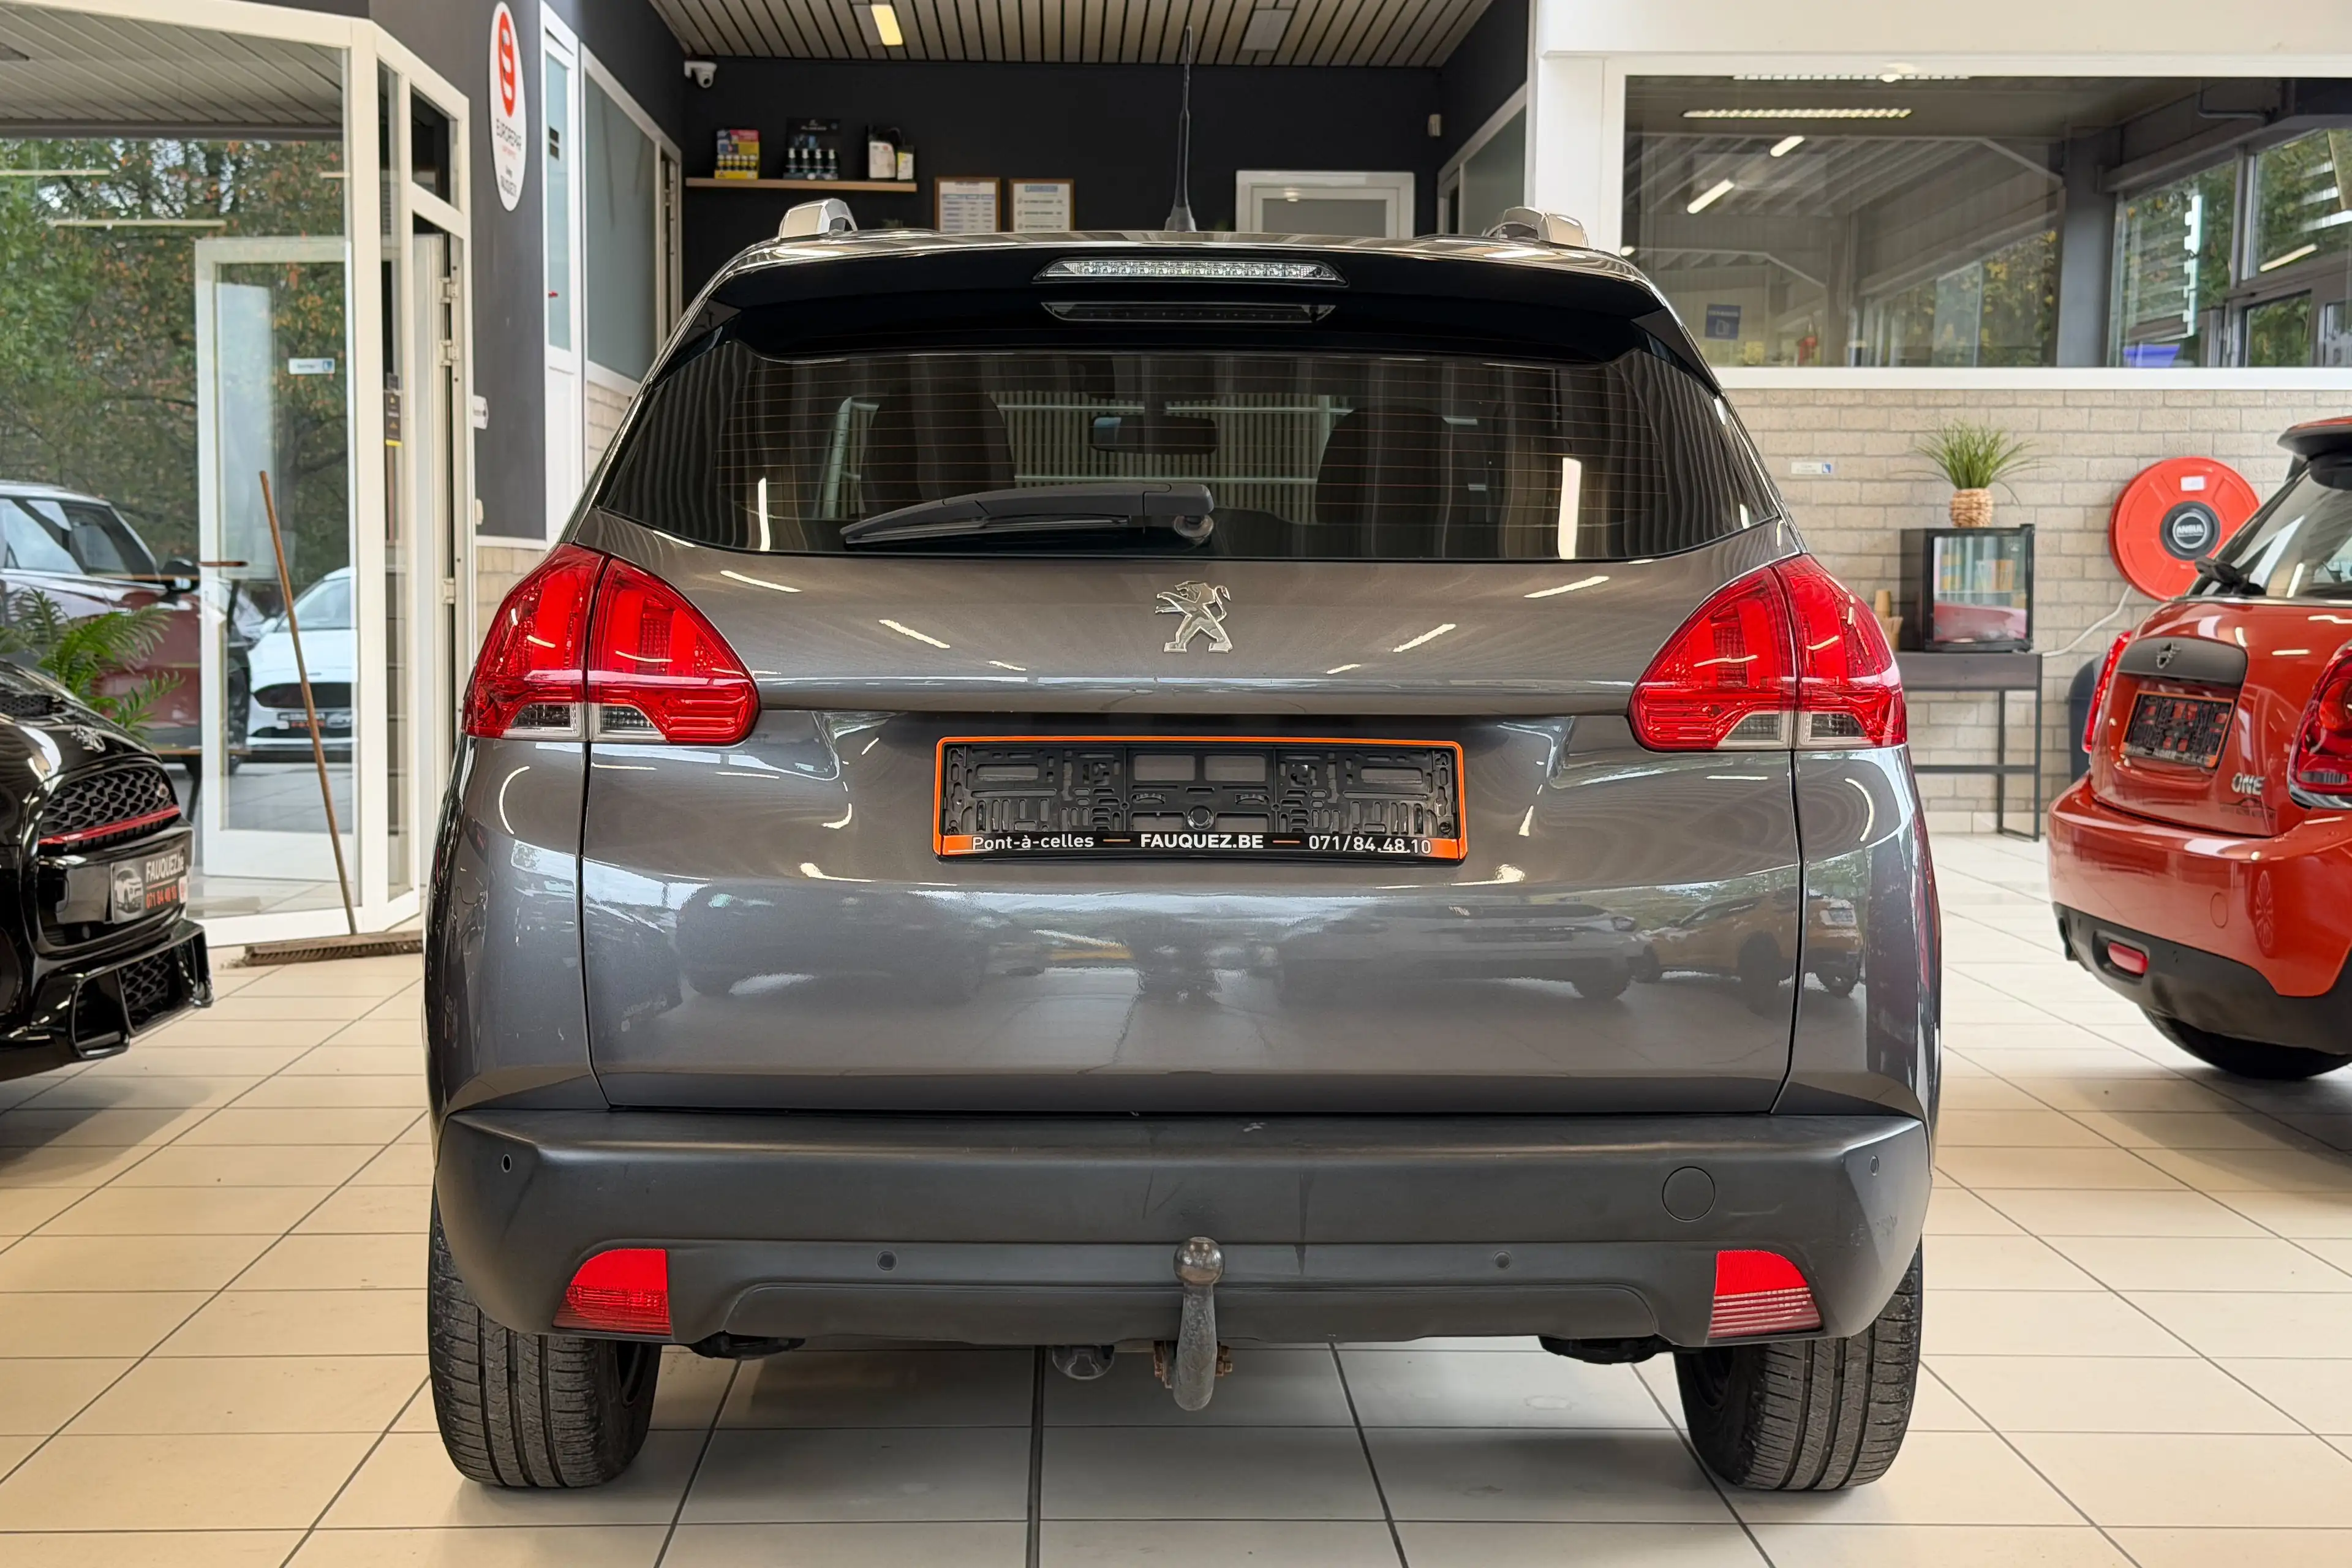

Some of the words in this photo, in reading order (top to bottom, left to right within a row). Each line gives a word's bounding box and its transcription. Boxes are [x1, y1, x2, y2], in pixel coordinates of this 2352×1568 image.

[2231, 772, 2266, 796] ONE
[972, 833, 1095, 851] Pont-à-celles
[1140, 833, 1264, 849] FAUQUEZ.BE
[1308, 835, 1432, 854] 071/84.48.10
